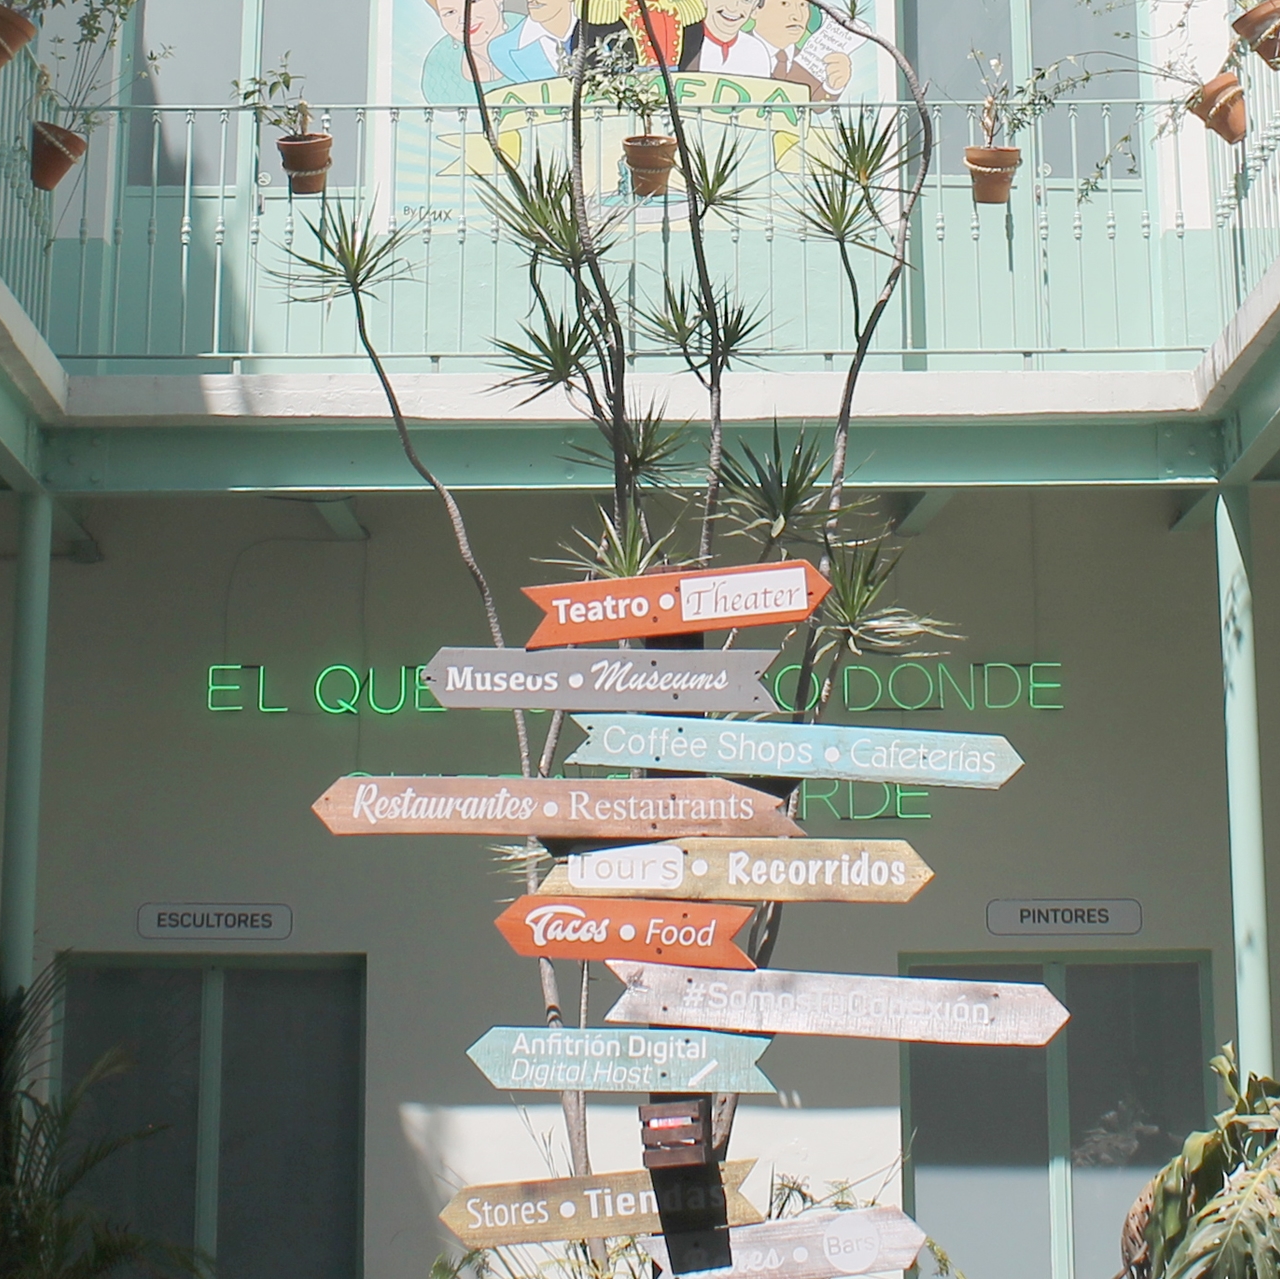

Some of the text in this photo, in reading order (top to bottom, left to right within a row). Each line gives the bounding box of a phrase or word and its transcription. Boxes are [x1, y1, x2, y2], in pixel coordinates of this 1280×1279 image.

[403, 206, 417, 218] By
[551, 580, 801, 624] Teatro Theater
[207, 665, 288, 712] EL
[445, 666, 558, 692] Museos
[589, 659, 729, 691] Museums
[844, 663, 1064, 711] DONDE
[603, 725, 996, 774] Coffee Shops Cafeterías
[353, 783, 754, 824] Restaurantes Restaurants
[802, 778, 932, 820] RDE
[575, 851, 905, 885] Tours Recorridos
[156, 912, 273, 929] ESCULTORES
[524, 905, 717, 948] Tacos Food
[1019, 908, 1110, 924] PINTORES
[511, 1032, 707, 1063] Anfitrión Digital
[511, 1058, 653, 1087] Digital Host
[466, 1197, 549, 1230] Stores
[827, 1235, 876, 1256] Bars
